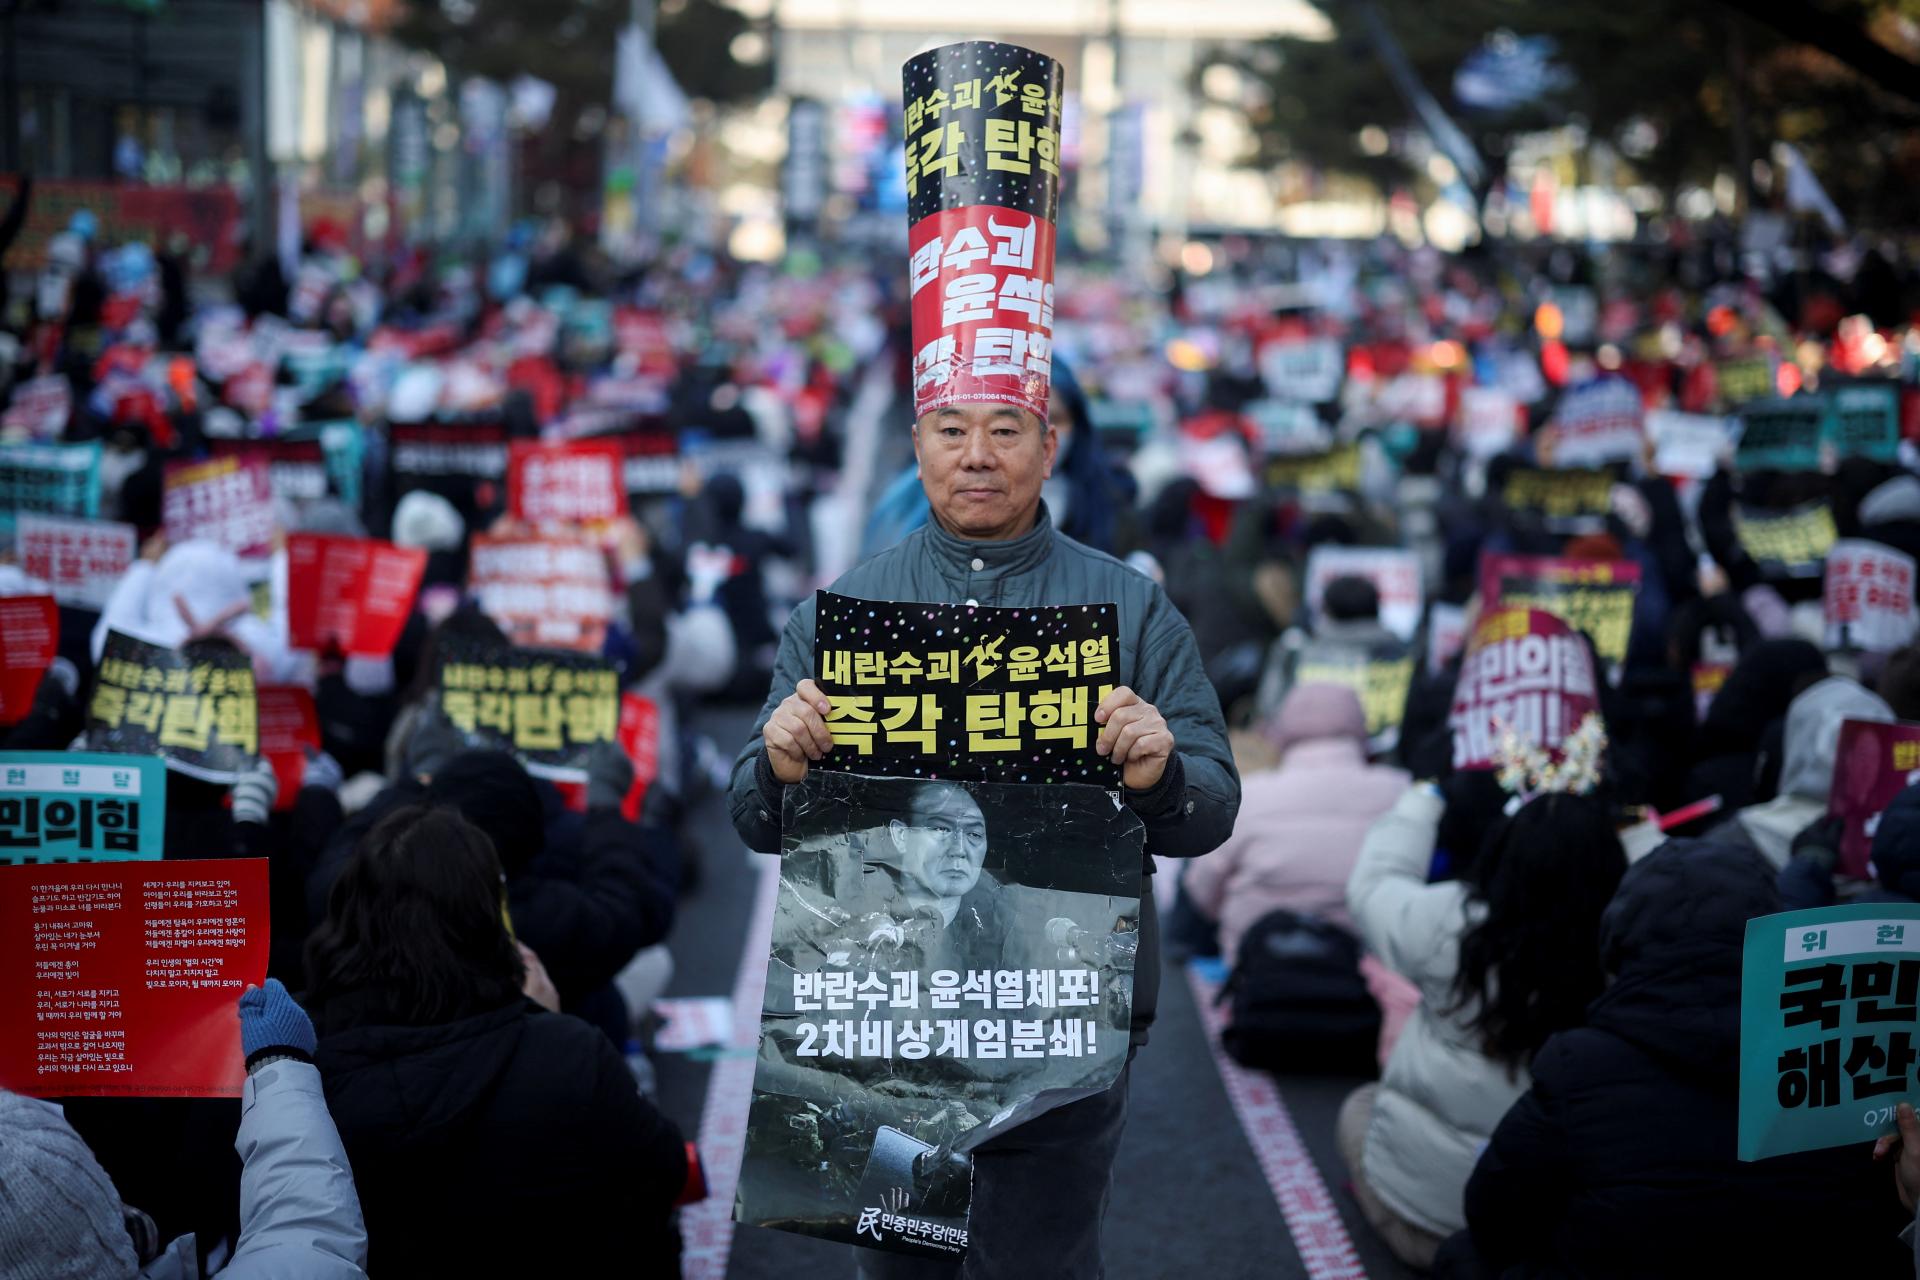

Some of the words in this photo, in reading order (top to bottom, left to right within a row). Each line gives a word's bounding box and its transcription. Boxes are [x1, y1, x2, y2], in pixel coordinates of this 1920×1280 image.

[904, 79, 981, 140] 란수괴
[910, 214, 1036, 300] 란수괴
[822, 650, 959, 685] 내란수괴
[1006, 635, 1112, 682] 윤석열
[824, 694, 943, 755] 즉각
[793, 970, 919, 1011] 반란수괴
[929, 970, 1099, 1009] 윤석열체포!
[796, 1018, 1097, 1059] 2차비상계엄분쇄!
[1778, 1032, 1920, 1108] 해산
[922, 1239, 948, 1251] Democracy
[948, 1245, 961, 1254] Party
